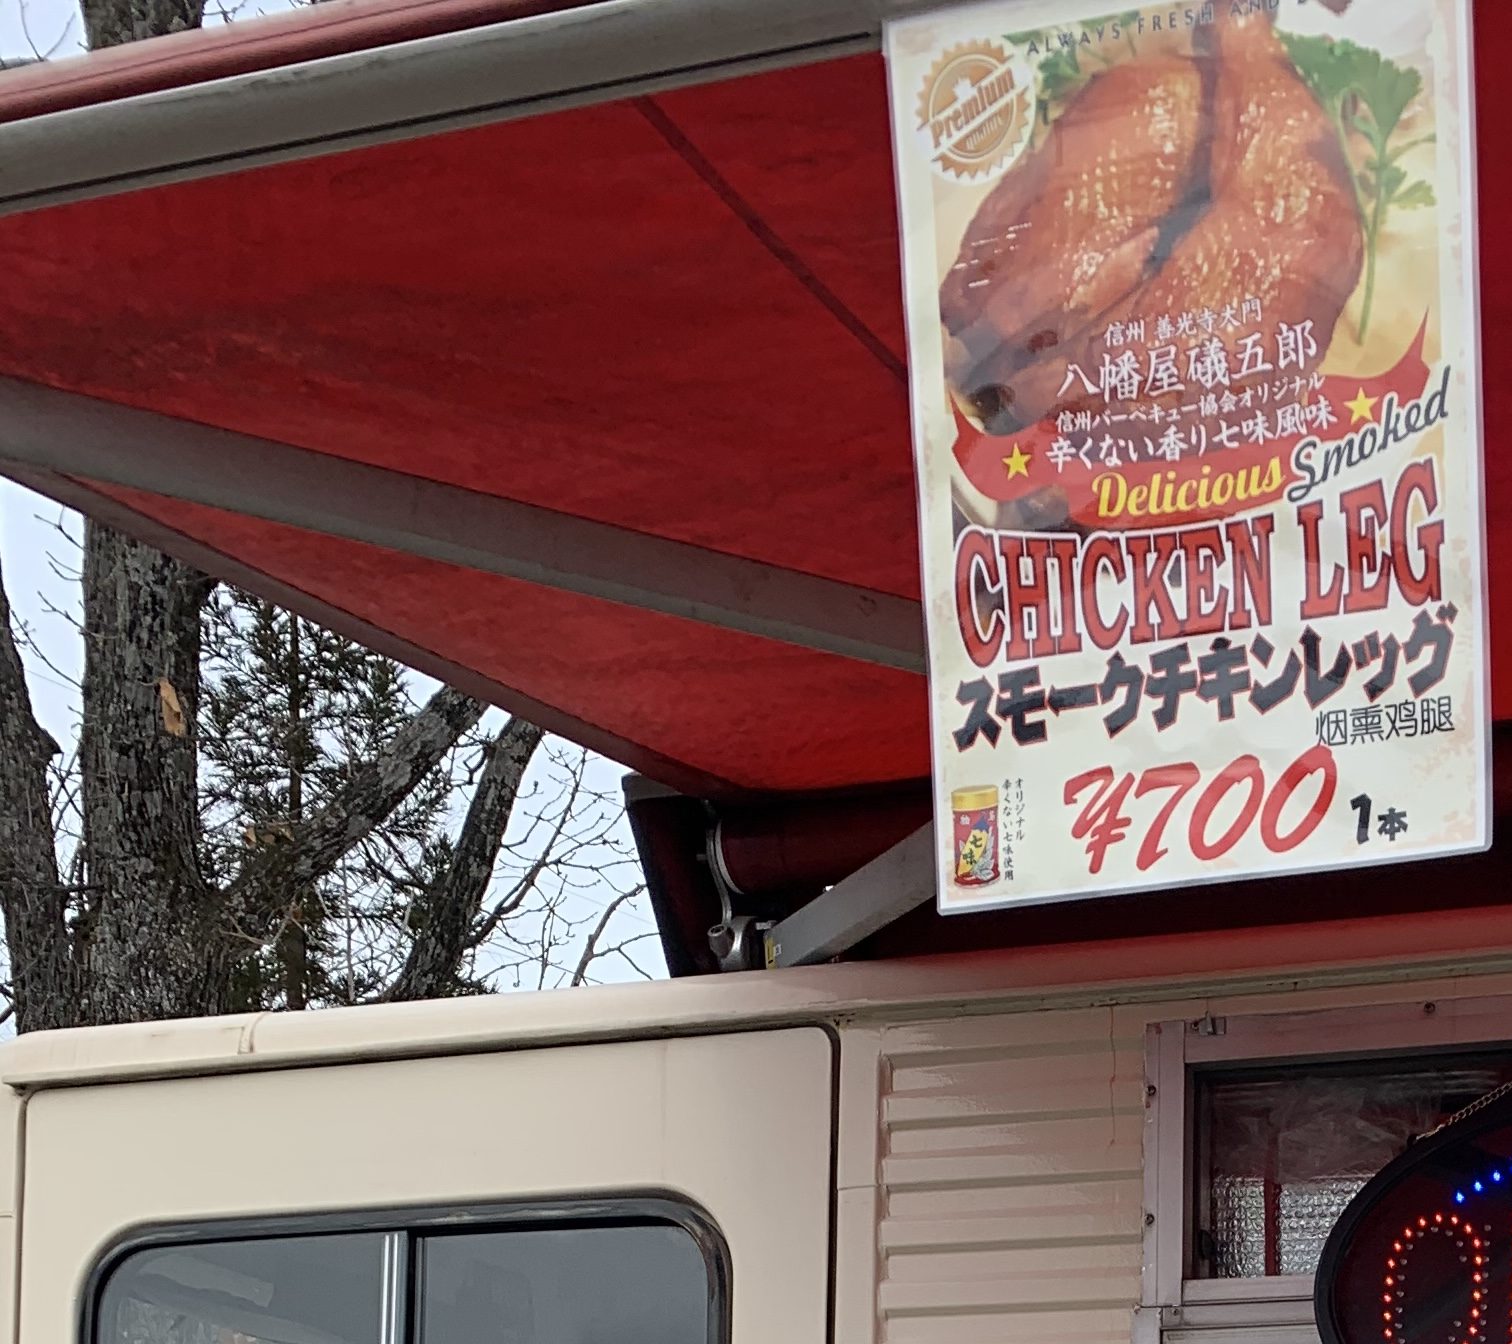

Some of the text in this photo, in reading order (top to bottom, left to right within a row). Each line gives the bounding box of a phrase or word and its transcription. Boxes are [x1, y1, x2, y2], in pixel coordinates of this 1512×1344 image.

[1092, 365, 1450, 518] Delicious Smoked
[952, 457, 1445, 668] CHICKEN LEG
[951, 601, 1459, 753] スモークチキンレッグ
